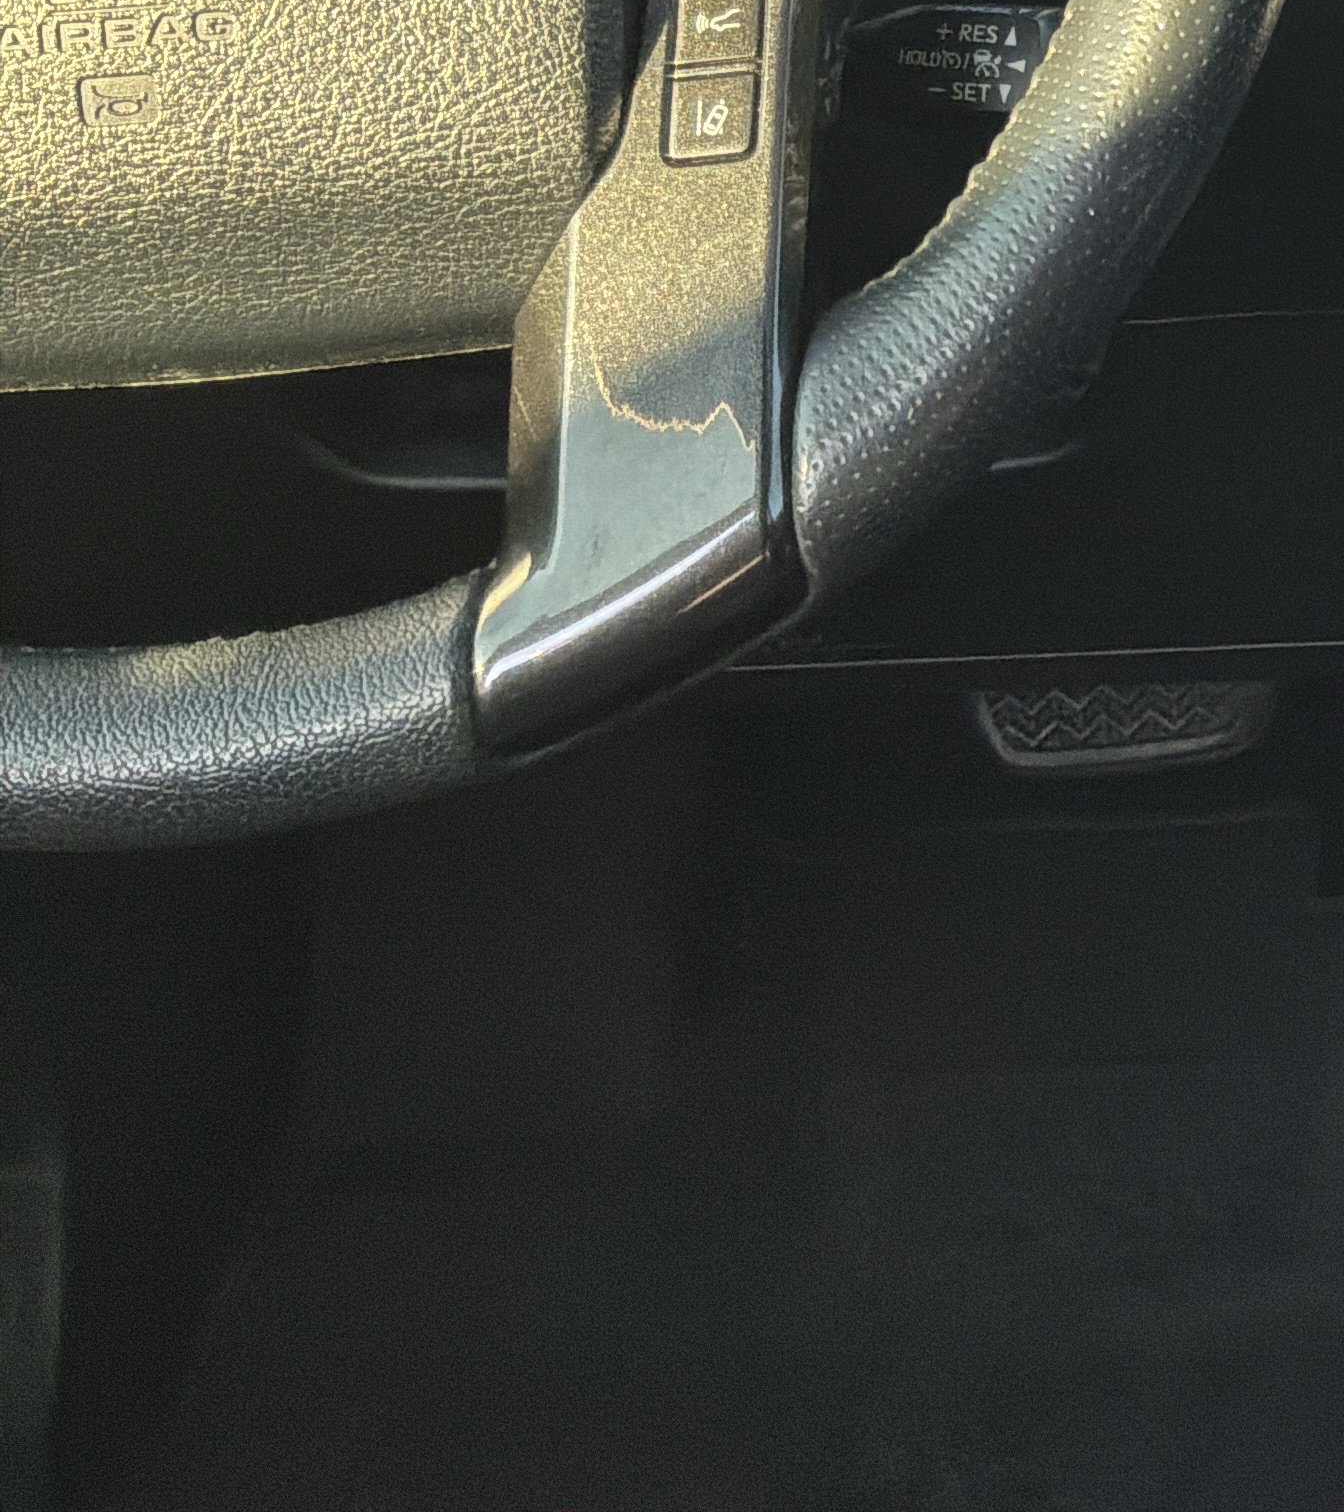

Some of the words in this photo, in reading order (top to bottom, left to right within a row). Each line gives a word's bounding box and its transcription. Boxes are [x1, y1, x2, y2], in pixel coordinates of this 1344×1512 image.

[0, 11, 238, 55] AIRBAG
[958, 23, 999, 44] RES
[951, 81, 991, 103] SET
